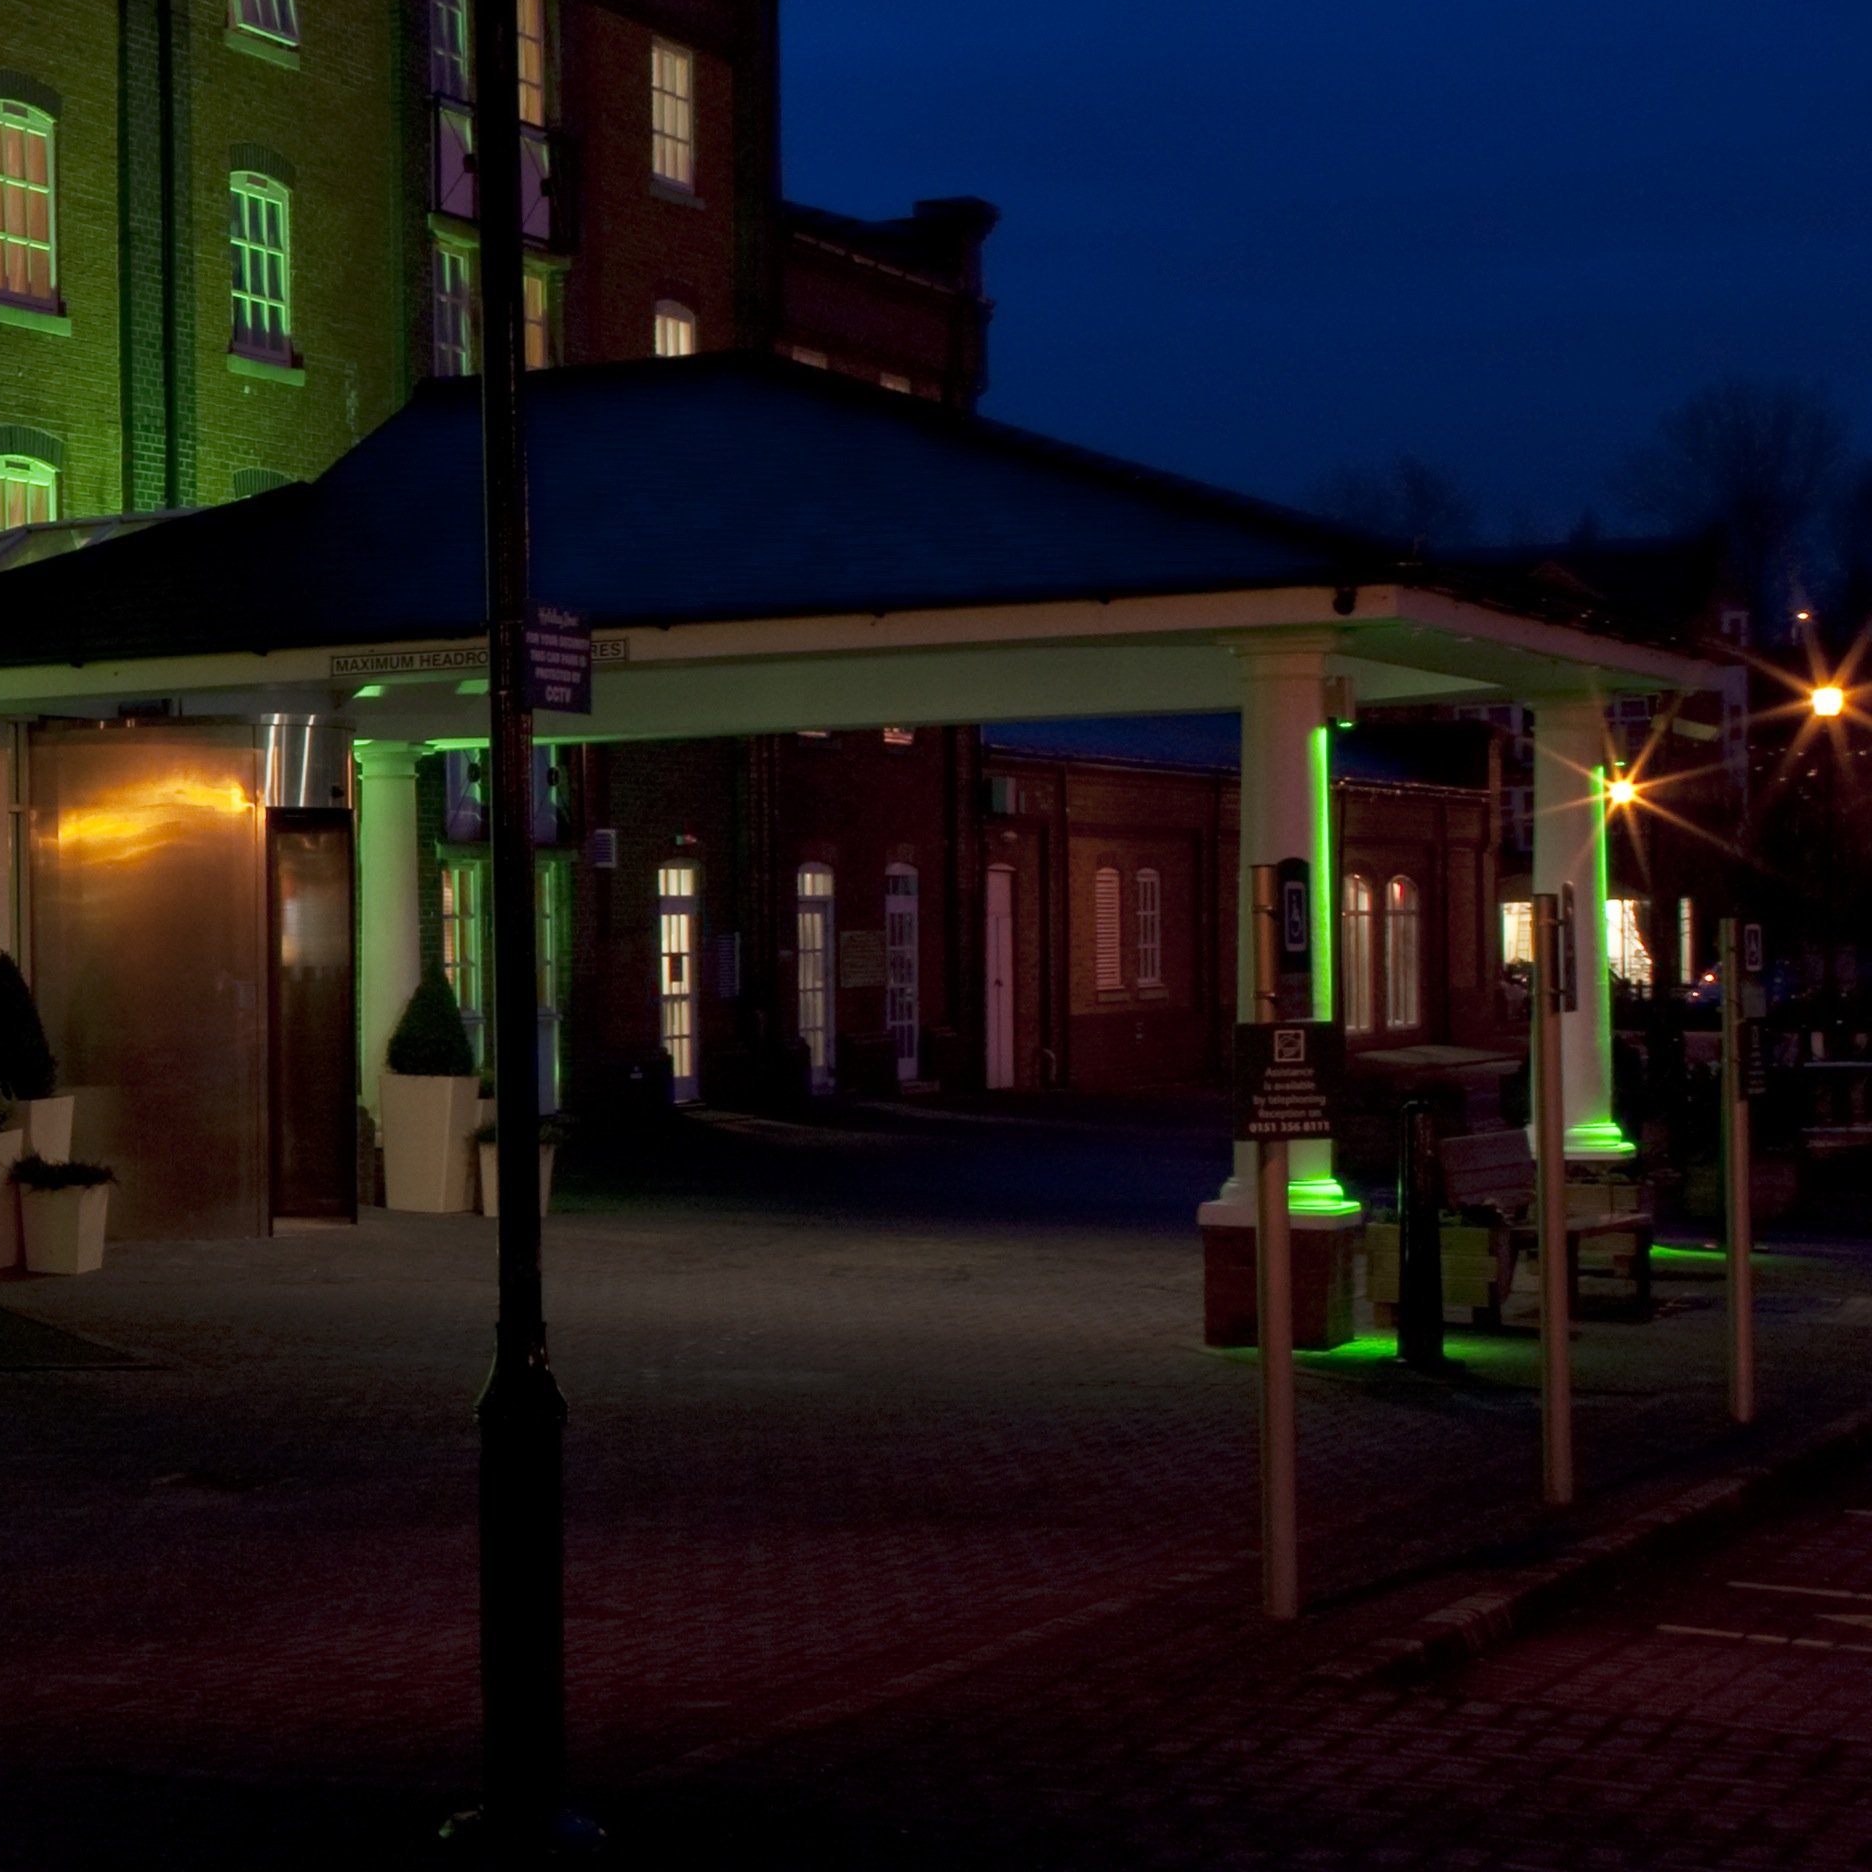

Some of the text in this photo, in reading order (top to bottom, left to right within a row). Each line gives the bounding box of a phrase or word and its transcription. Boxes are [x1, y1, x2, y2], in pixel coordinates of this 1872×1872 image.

[335, 652, 414, 673] MAXIMUM
[419, 649, 487, 667] HEADRO
[545, 685, 571, 703] CCTV
[1265, 1067, 1315, 1077] Assistance
[1274, 1081, 1316, 1091] available
[1252, 1094, 1327, 1109] by telephoning
[1258, 1109, 1322, 1119] Reception on
[1249, 1122, 1277, 1133] 0151
